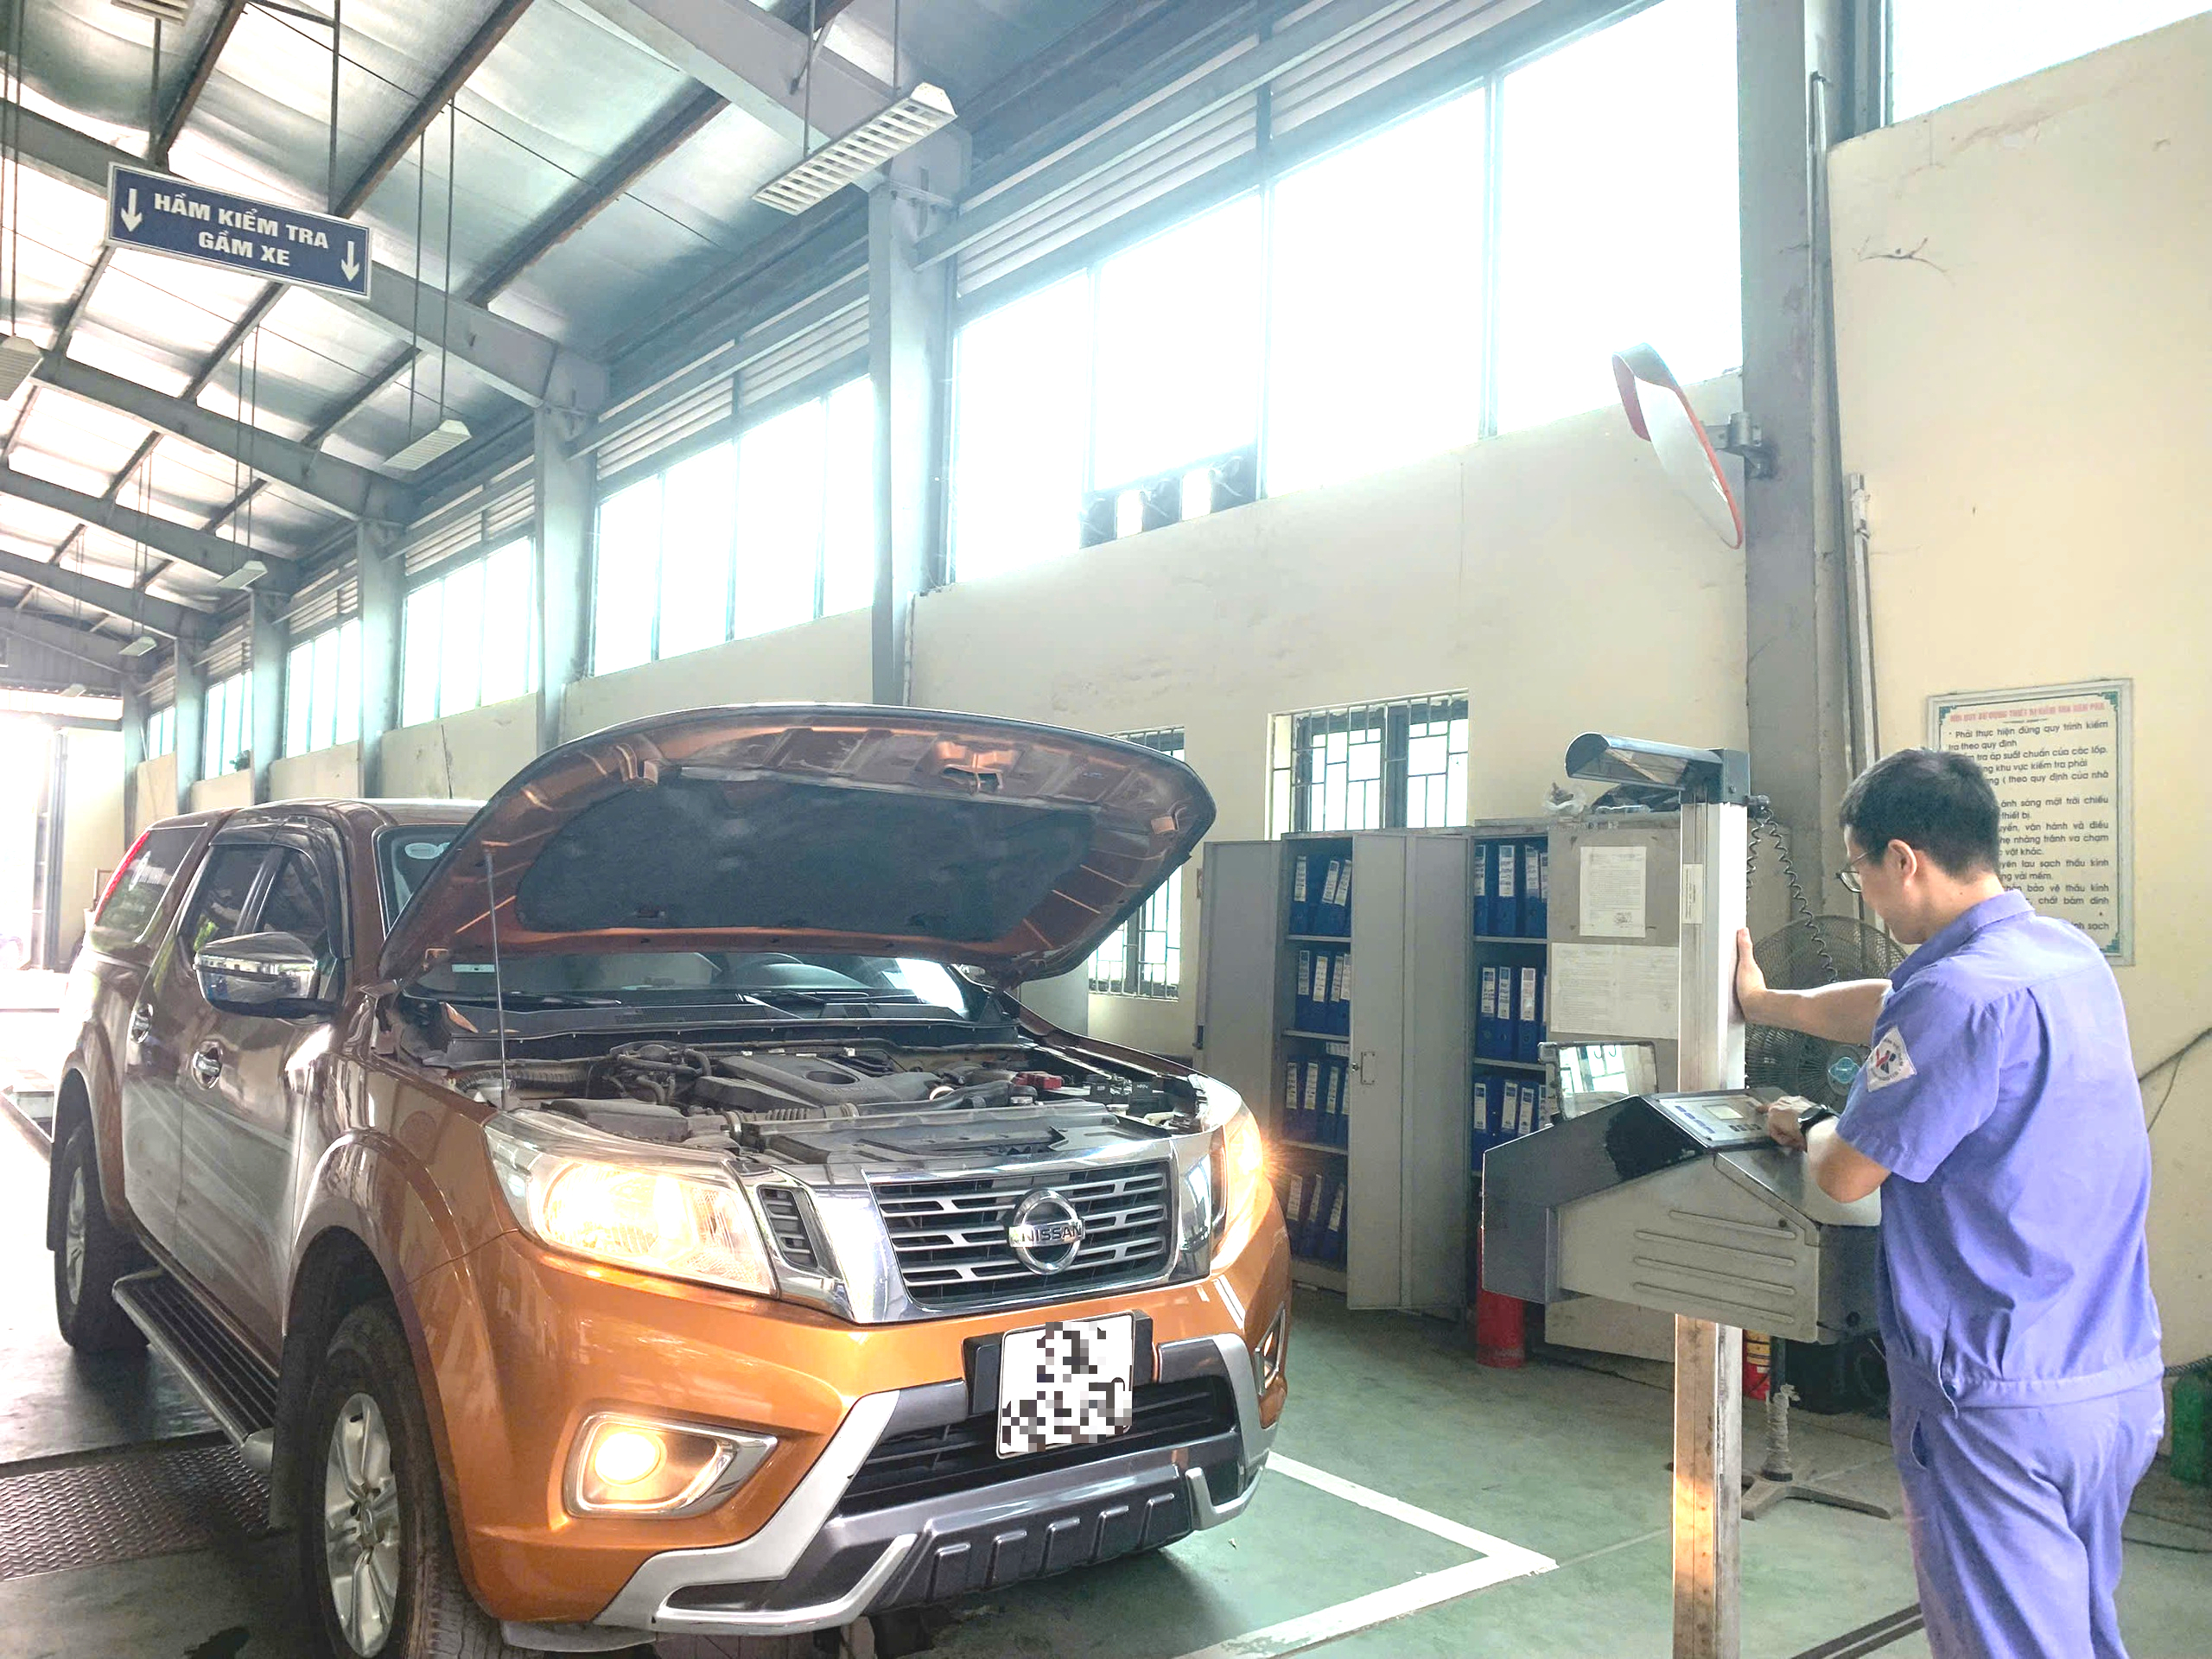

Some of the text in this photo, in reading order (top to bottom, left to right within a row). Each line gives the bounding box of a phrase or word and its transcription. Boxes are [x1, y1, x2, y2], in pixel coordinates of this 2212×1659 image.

[154, 192, 329, 250] HẦM KIỂM TRA
[198, 230, 290, 267] GẦM XE
[2044, 725, 2060, 733] quy
[1981, 741, 1997, 750] quy
[1996, 764, 2011, 772] khu
[2009, 775, 2028, 783] theo
[2031, 775, 2046, 783] quy
[1022, 1224, 1081, 1243] NISSAN
